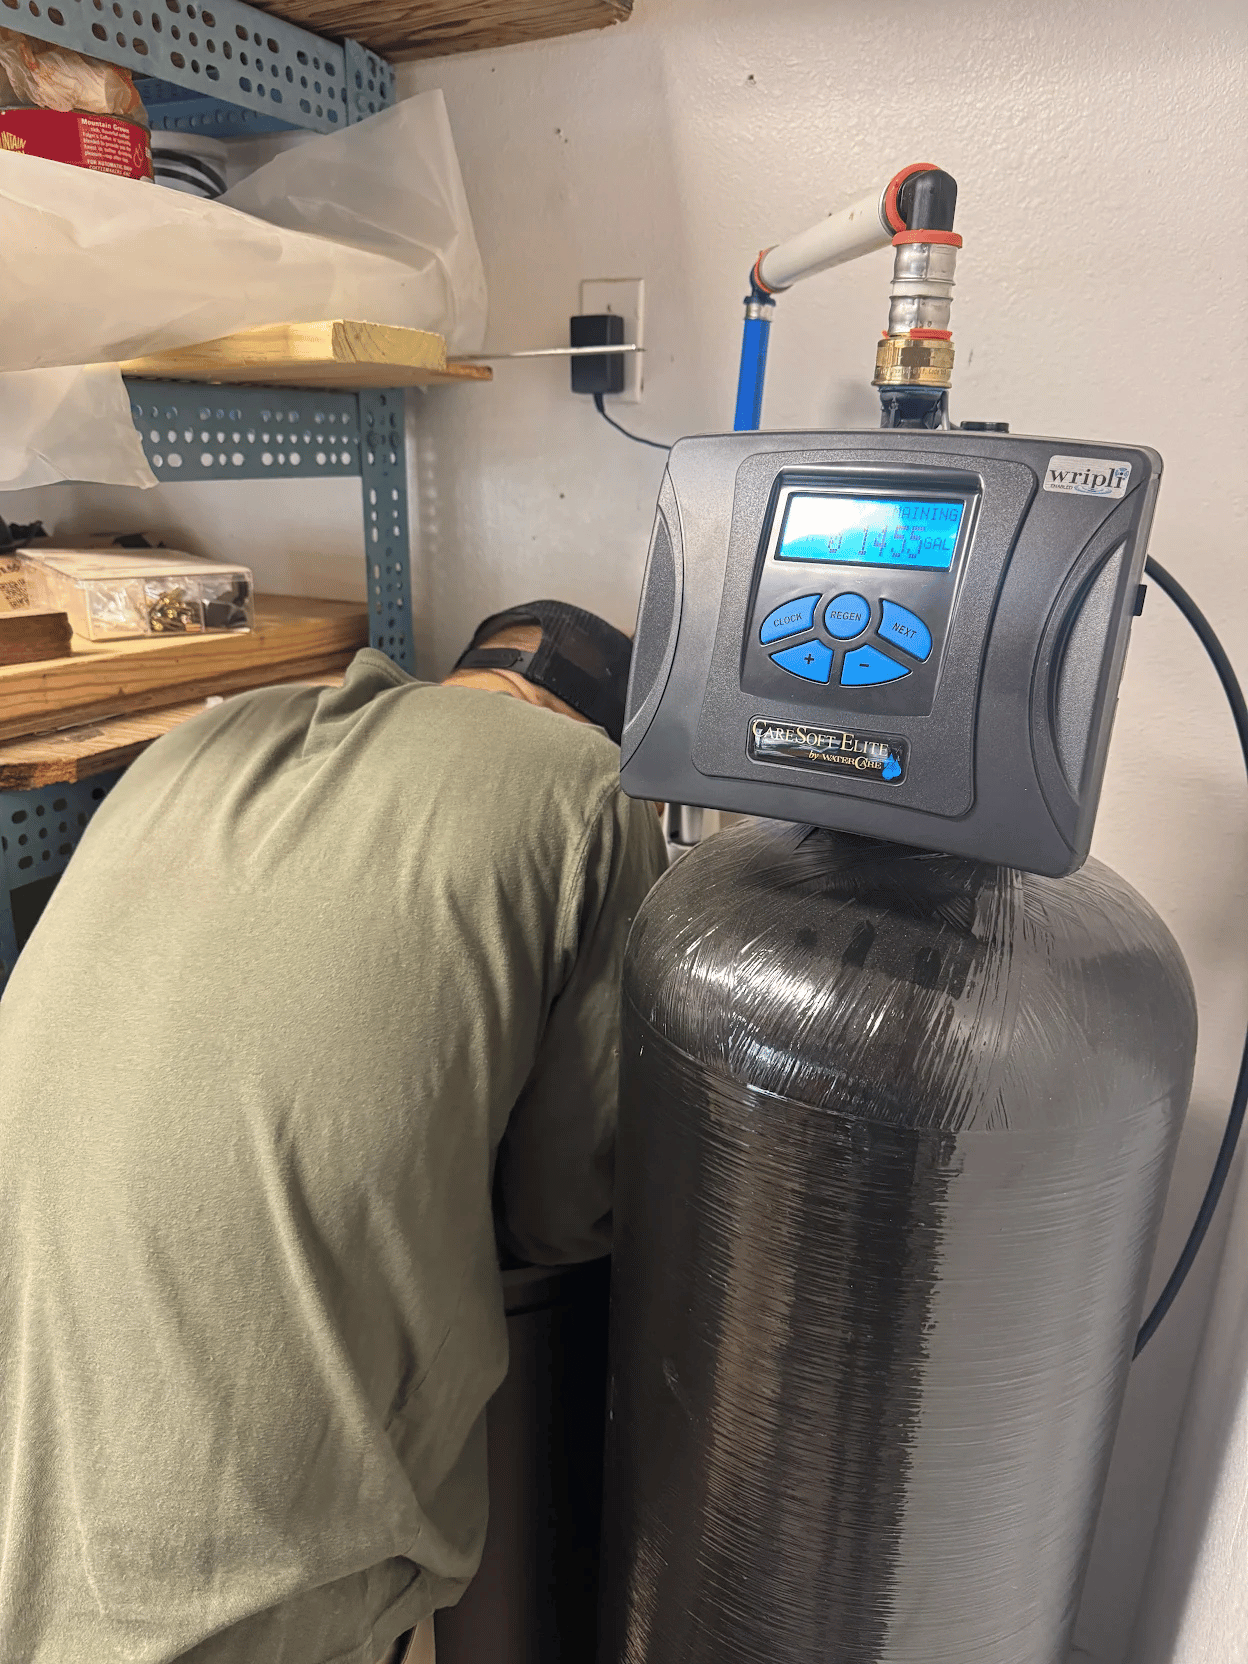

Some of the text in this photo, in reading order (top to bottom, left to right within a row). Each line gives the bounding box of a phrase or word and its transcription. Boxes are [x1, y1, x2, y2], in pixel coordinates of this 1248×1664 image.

[81, 117, 130, 133] Mountain Grown
[97, 159, 123, 169] AUTOMATIC
[1049, 466, 1125, 489] wripli
[892, 505, 959, 523] MAINING
[923, 535, 951, 552] GAL
[773, 611, 803, 628] CLOCK
[830, 609, 863, 623] REGEN
[892, 621, 918, 640] NEXT
[808, 750, 820, 761] by
